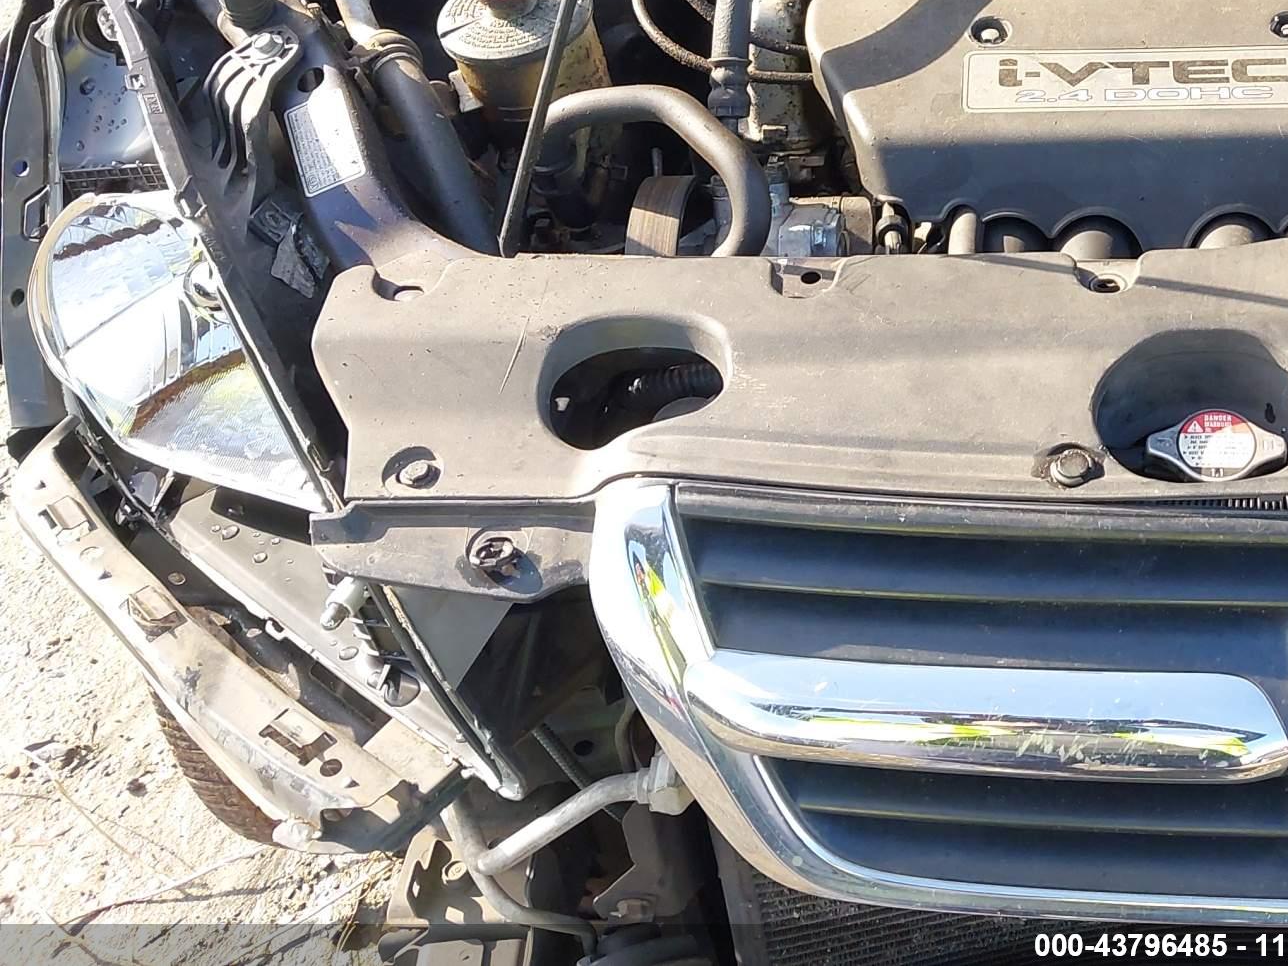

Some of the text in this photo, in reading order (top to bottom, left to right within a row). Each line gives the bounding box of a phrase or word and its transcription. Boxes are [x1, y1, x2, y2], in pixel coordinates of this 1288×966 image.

[998, 58, 1288, 87] i-VTEC
[1015, 86, 1274, 103] 2.4 DOHC
